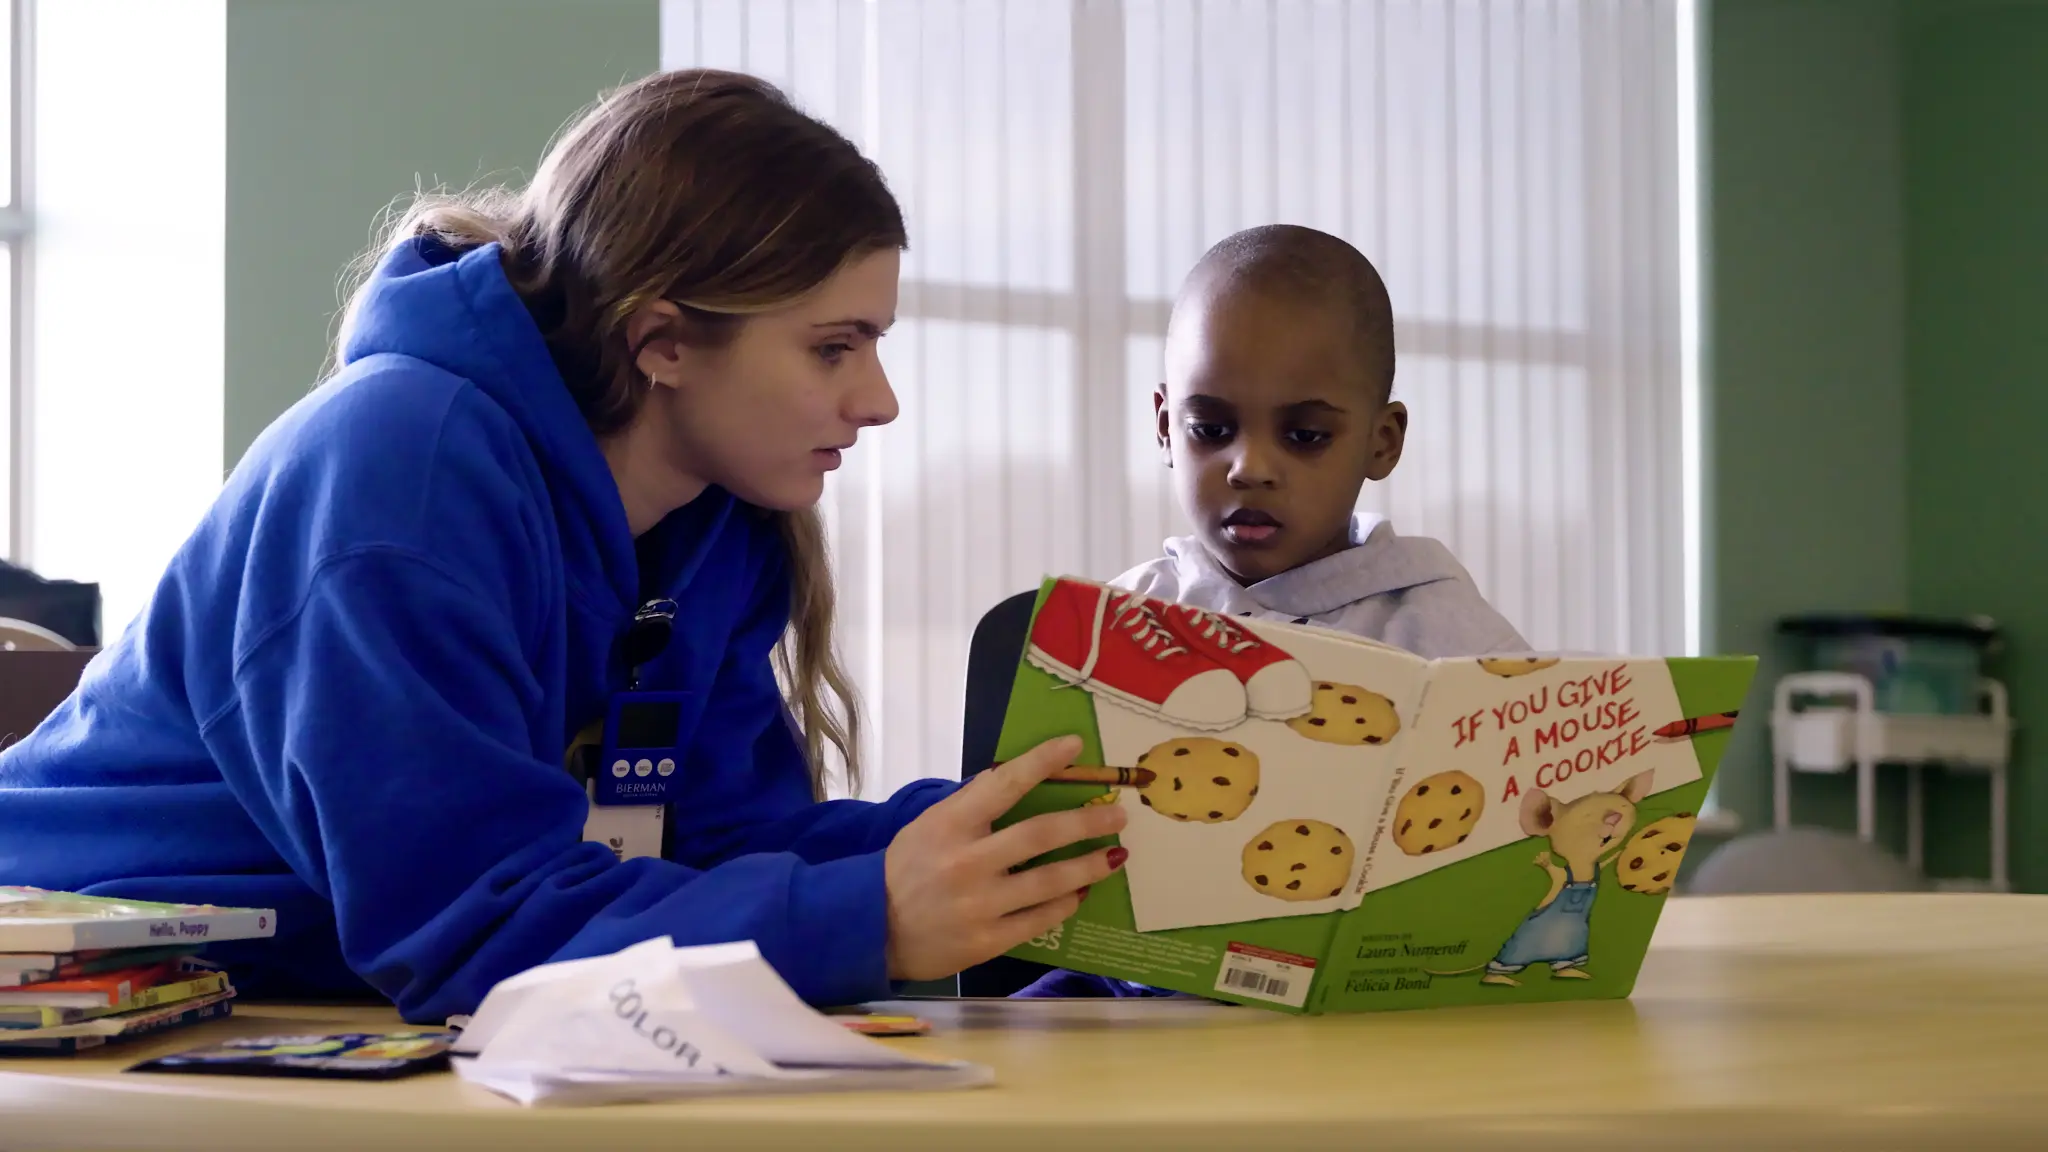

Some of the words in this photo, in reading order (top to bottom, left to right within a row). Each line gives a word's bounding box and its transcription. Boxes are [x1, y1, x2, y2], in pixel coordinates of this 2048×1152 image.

[1452, 709, 1485, 748] IF
[1492, 686, 1548, 730] YOU
[1557, 663, 1632, 708] GIVE
[1502, 736, 1520, 766] A
[1534, 698, 1640, 753] MOUSE
[1501, 776, 1519, 803] A
[1535, 725, 1650, 789] COOKIE
[616, 783, 666, 793] BIERMAN
[1368, 824, 1386, 854] Mouse
[179, 921, 209, 937] Puppy
[1356, 945, 1397, 959] Laura
[1401, 939, 1470, 957] Numeroff
[1344, 977, 1390, 994] Felicia
[1394, 975, 1433, 991] Bond
[609, 978, 702, 1068] COLOR
